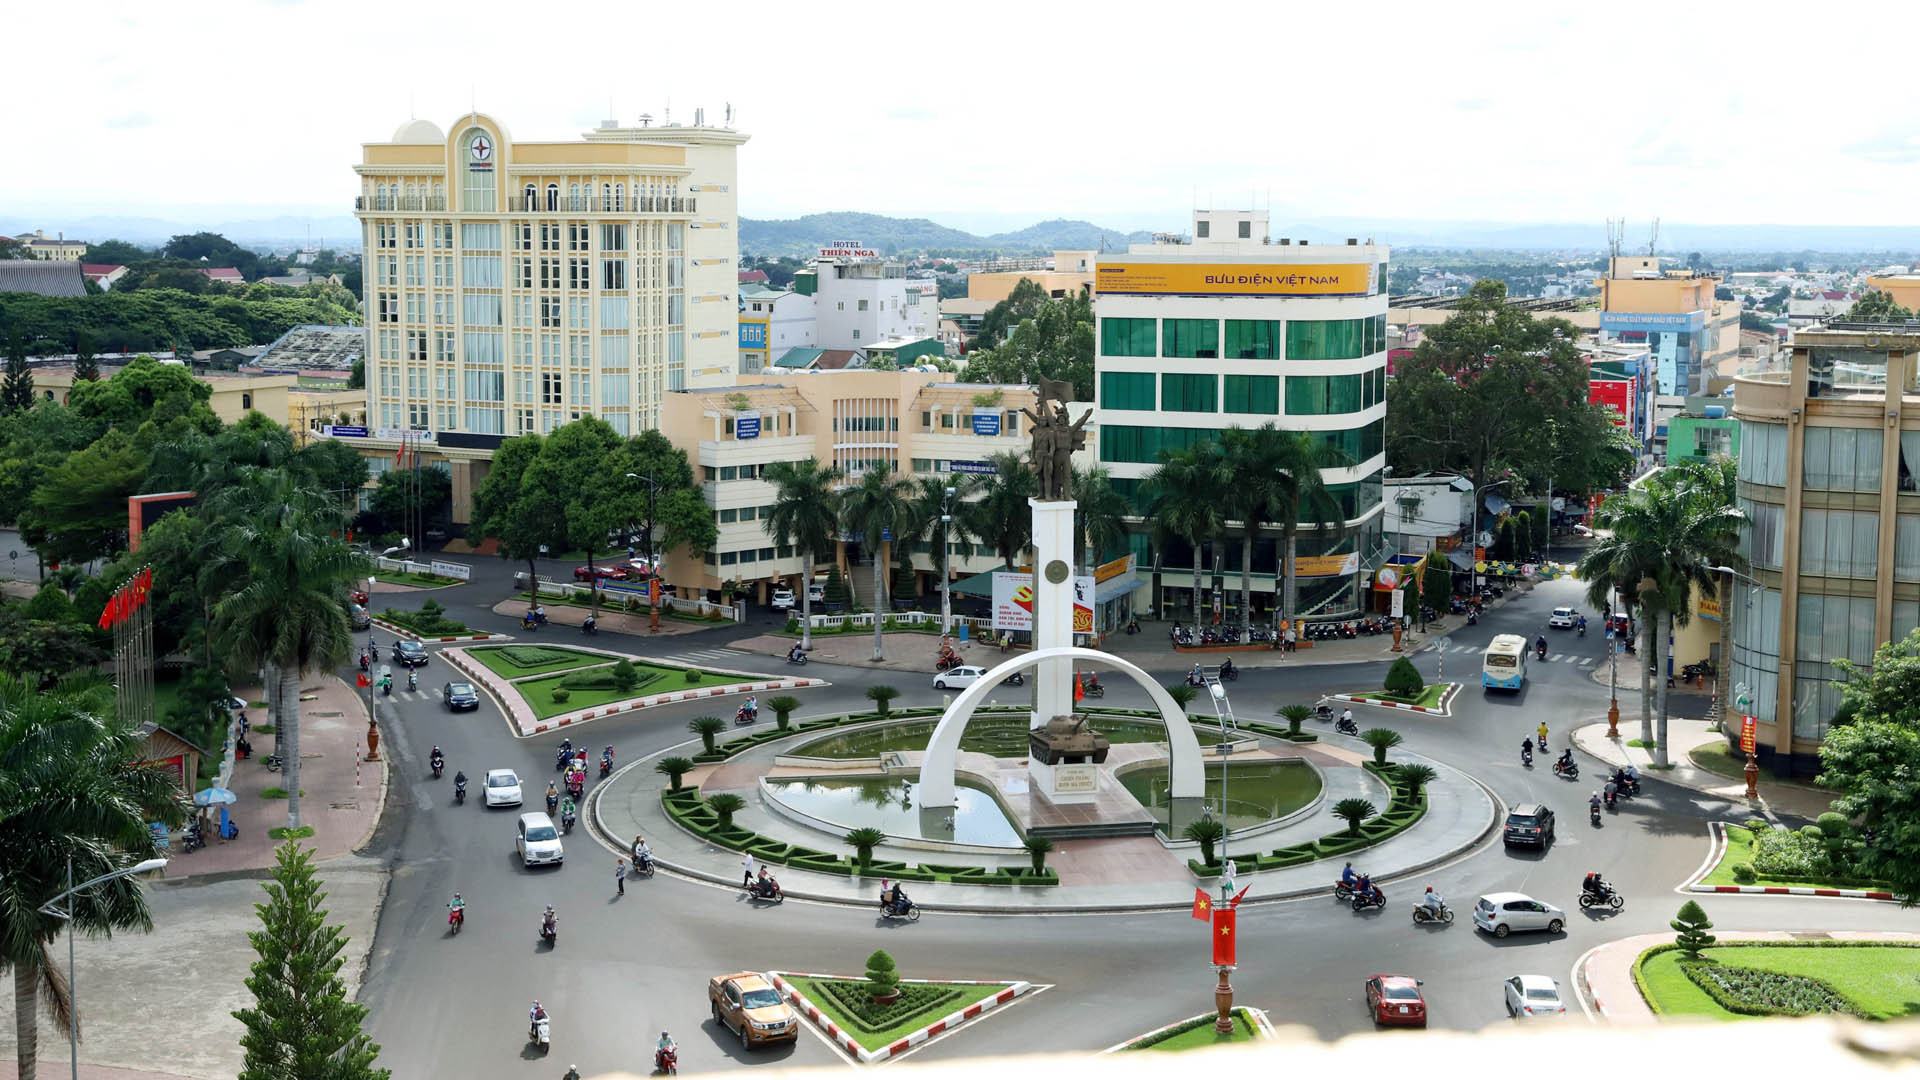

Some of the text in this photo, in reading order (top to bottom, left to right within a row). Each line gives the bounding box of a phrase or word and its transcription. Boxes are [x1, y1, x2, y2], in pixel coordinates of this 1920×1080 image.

[1205, 273, 1339, 286] BƯU ĐIỆN VIỆT NAM
